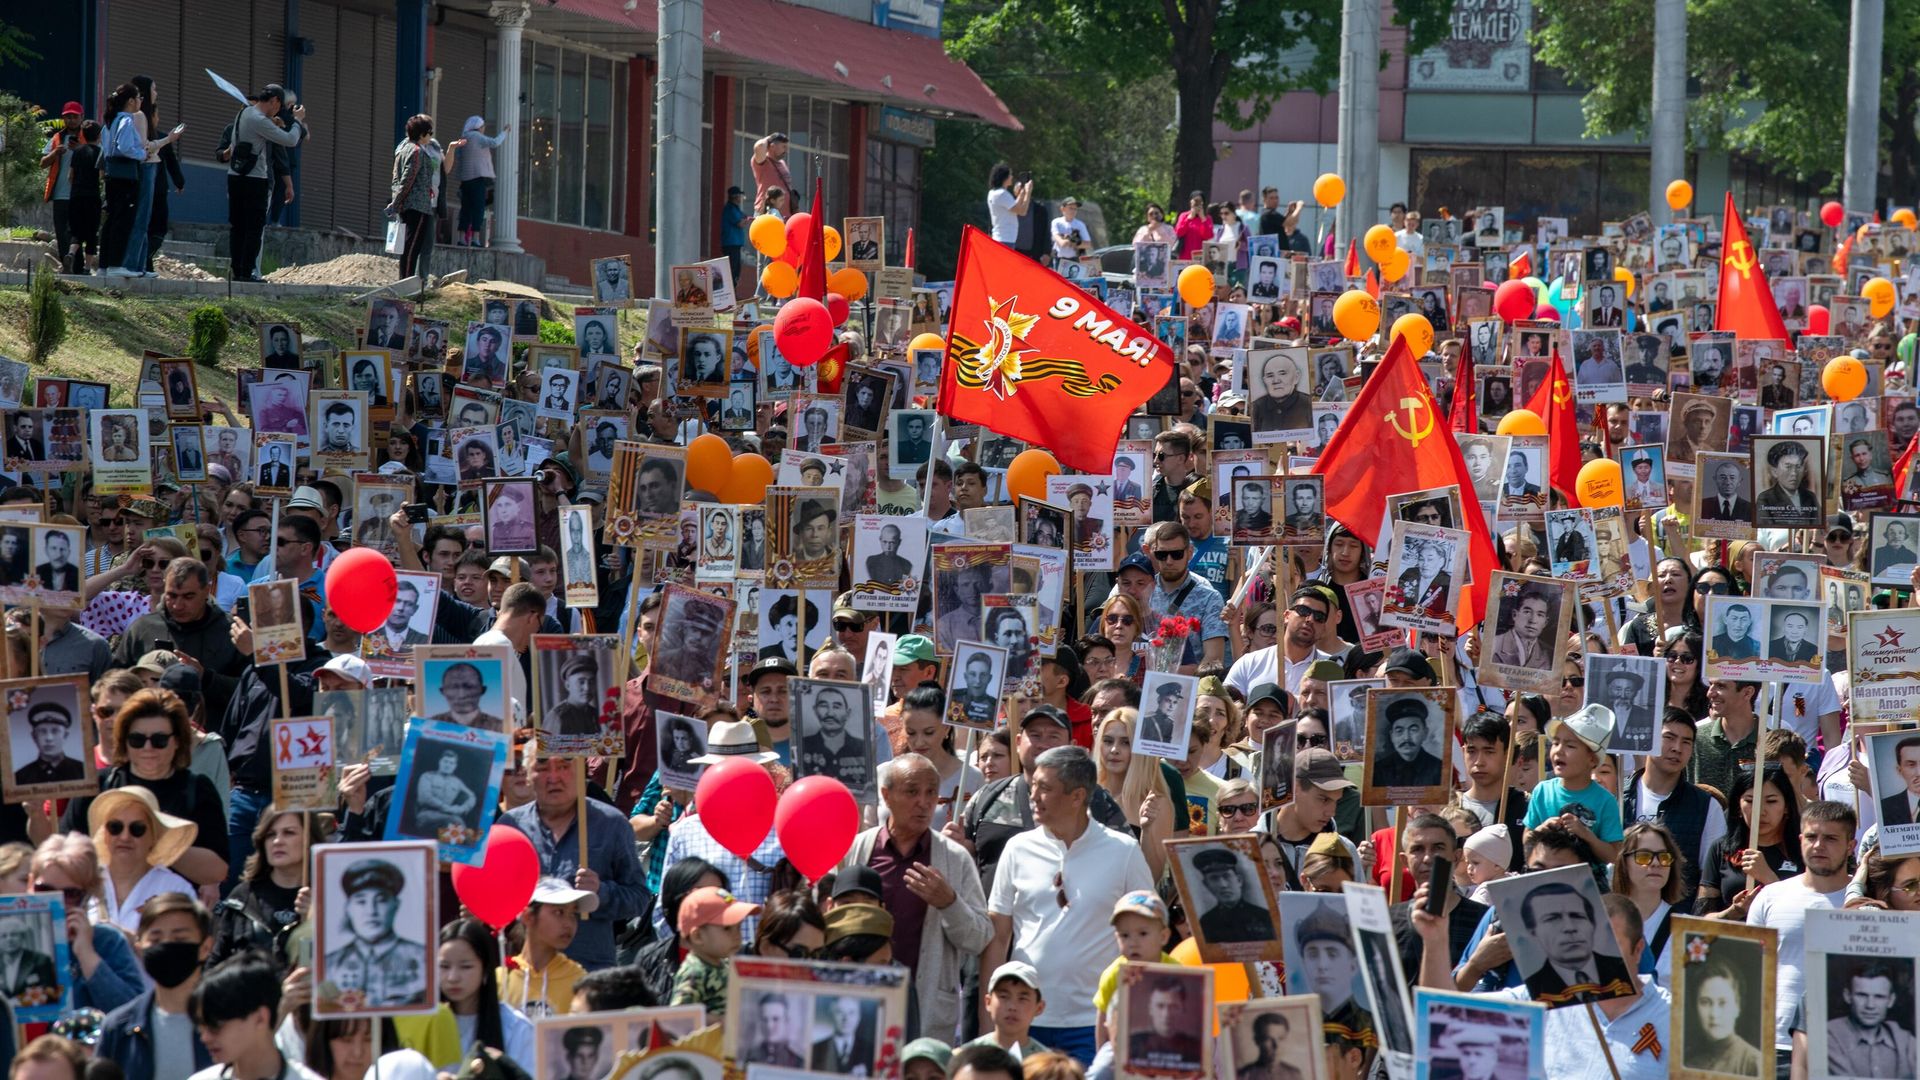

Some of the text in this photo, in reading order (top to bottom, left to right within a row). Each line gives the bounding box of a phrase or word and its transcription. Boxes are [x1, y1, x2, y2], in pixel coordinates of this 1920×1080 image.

[1049, 296, 1159, 368] 9 МАЯ!
[1207, 567, 1226, 584] 96
[1874, 655, 1907, 665] ПОЛК
[1878, 698, 1908, 710] Апас
[281, 783, 317, 791] Максим
[1829, 914, 1909, 924] СПАСИБО, ПАПА!
[1849, 935, 1889, 944] ПРАДЕД!
